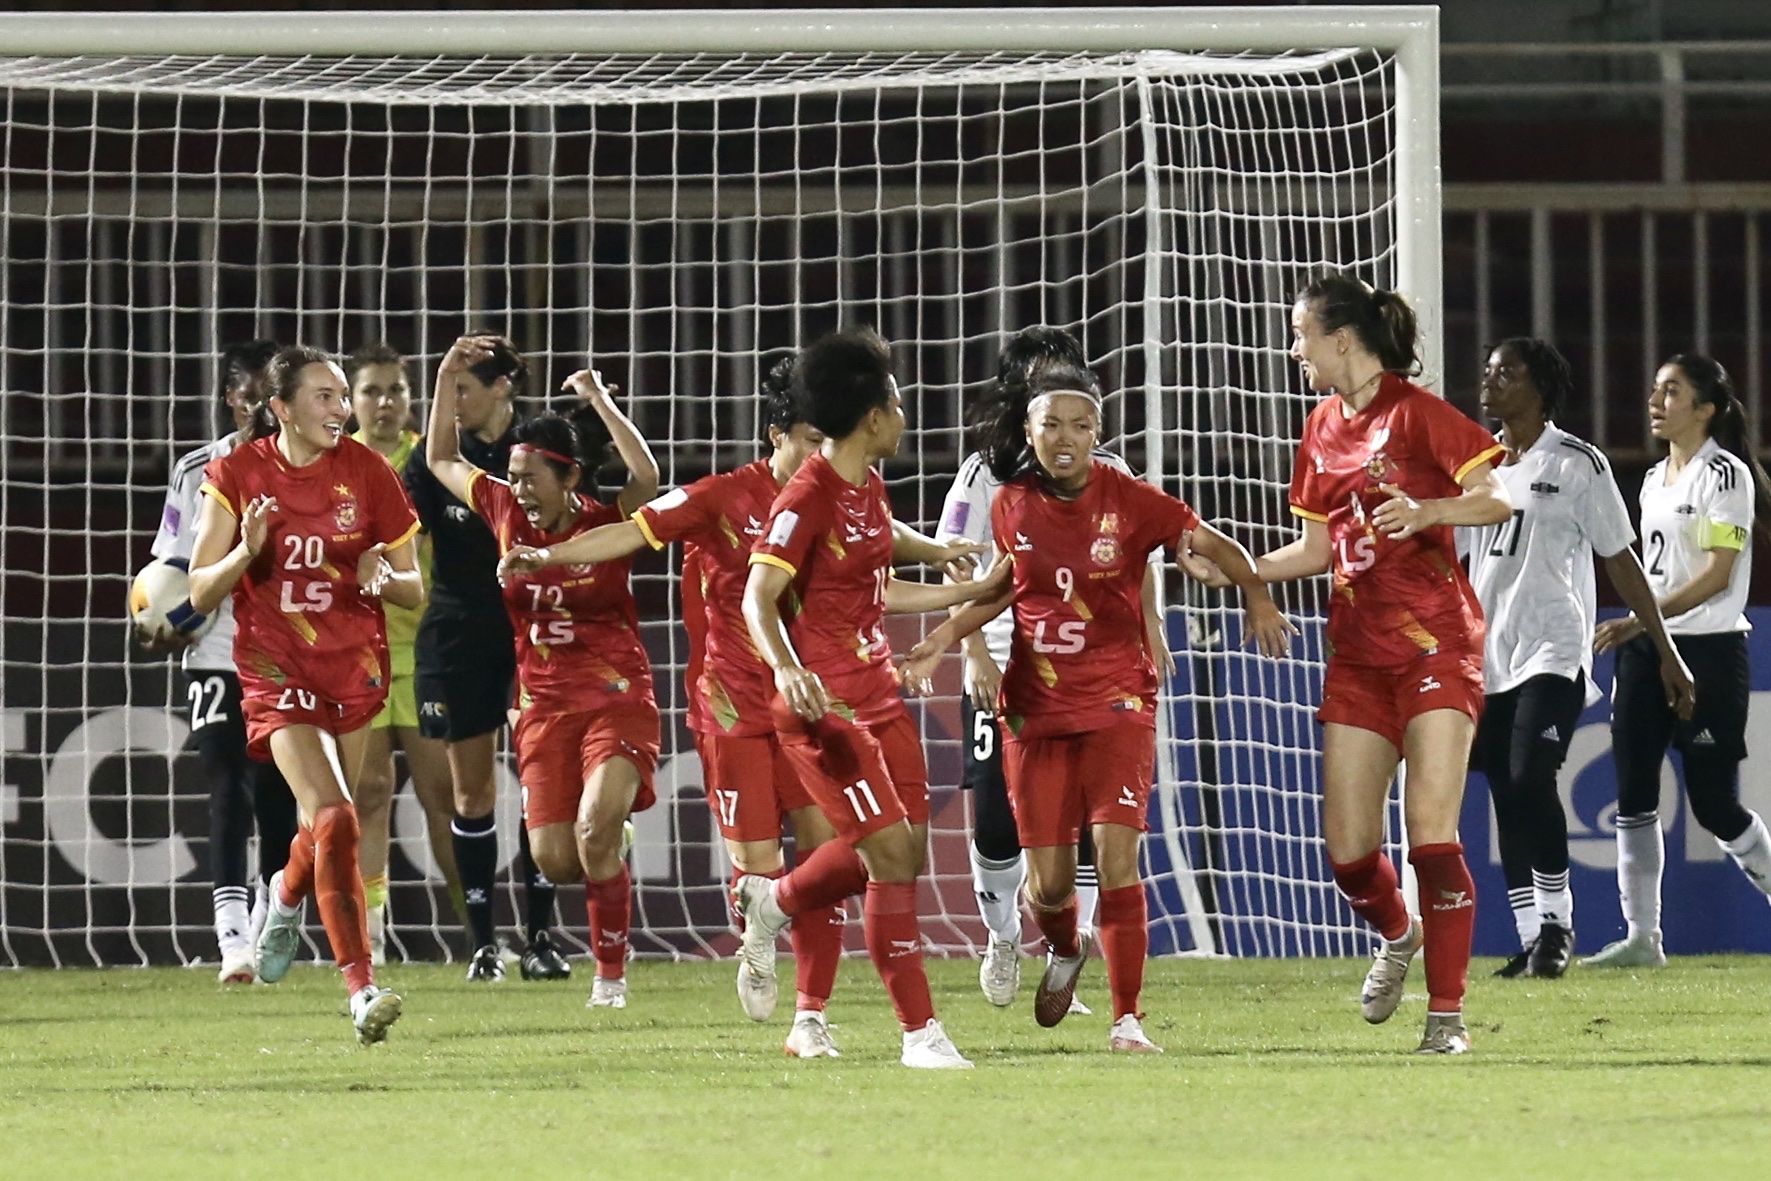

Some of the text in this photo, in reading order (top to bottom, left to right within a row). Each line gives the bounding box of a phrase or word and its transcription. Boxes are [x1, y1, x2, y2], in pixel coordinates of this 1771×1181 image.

[283, 534, 324, 571] 20
[1339, 535, 1376, 573] LS
[1649, 530, 1665, 575] 2
[280, 580, 334, 613] LS
[1055, 567, 1074, 602] 9
[529, 620, 575, 645] LS
[1032, 620, 1086, 654] LS
[188, 676, 228, 731] 22
[974, 711, 994, 761] 5
[716, 789, 739, 827] 17
[843, 779, 883, 822] 11
